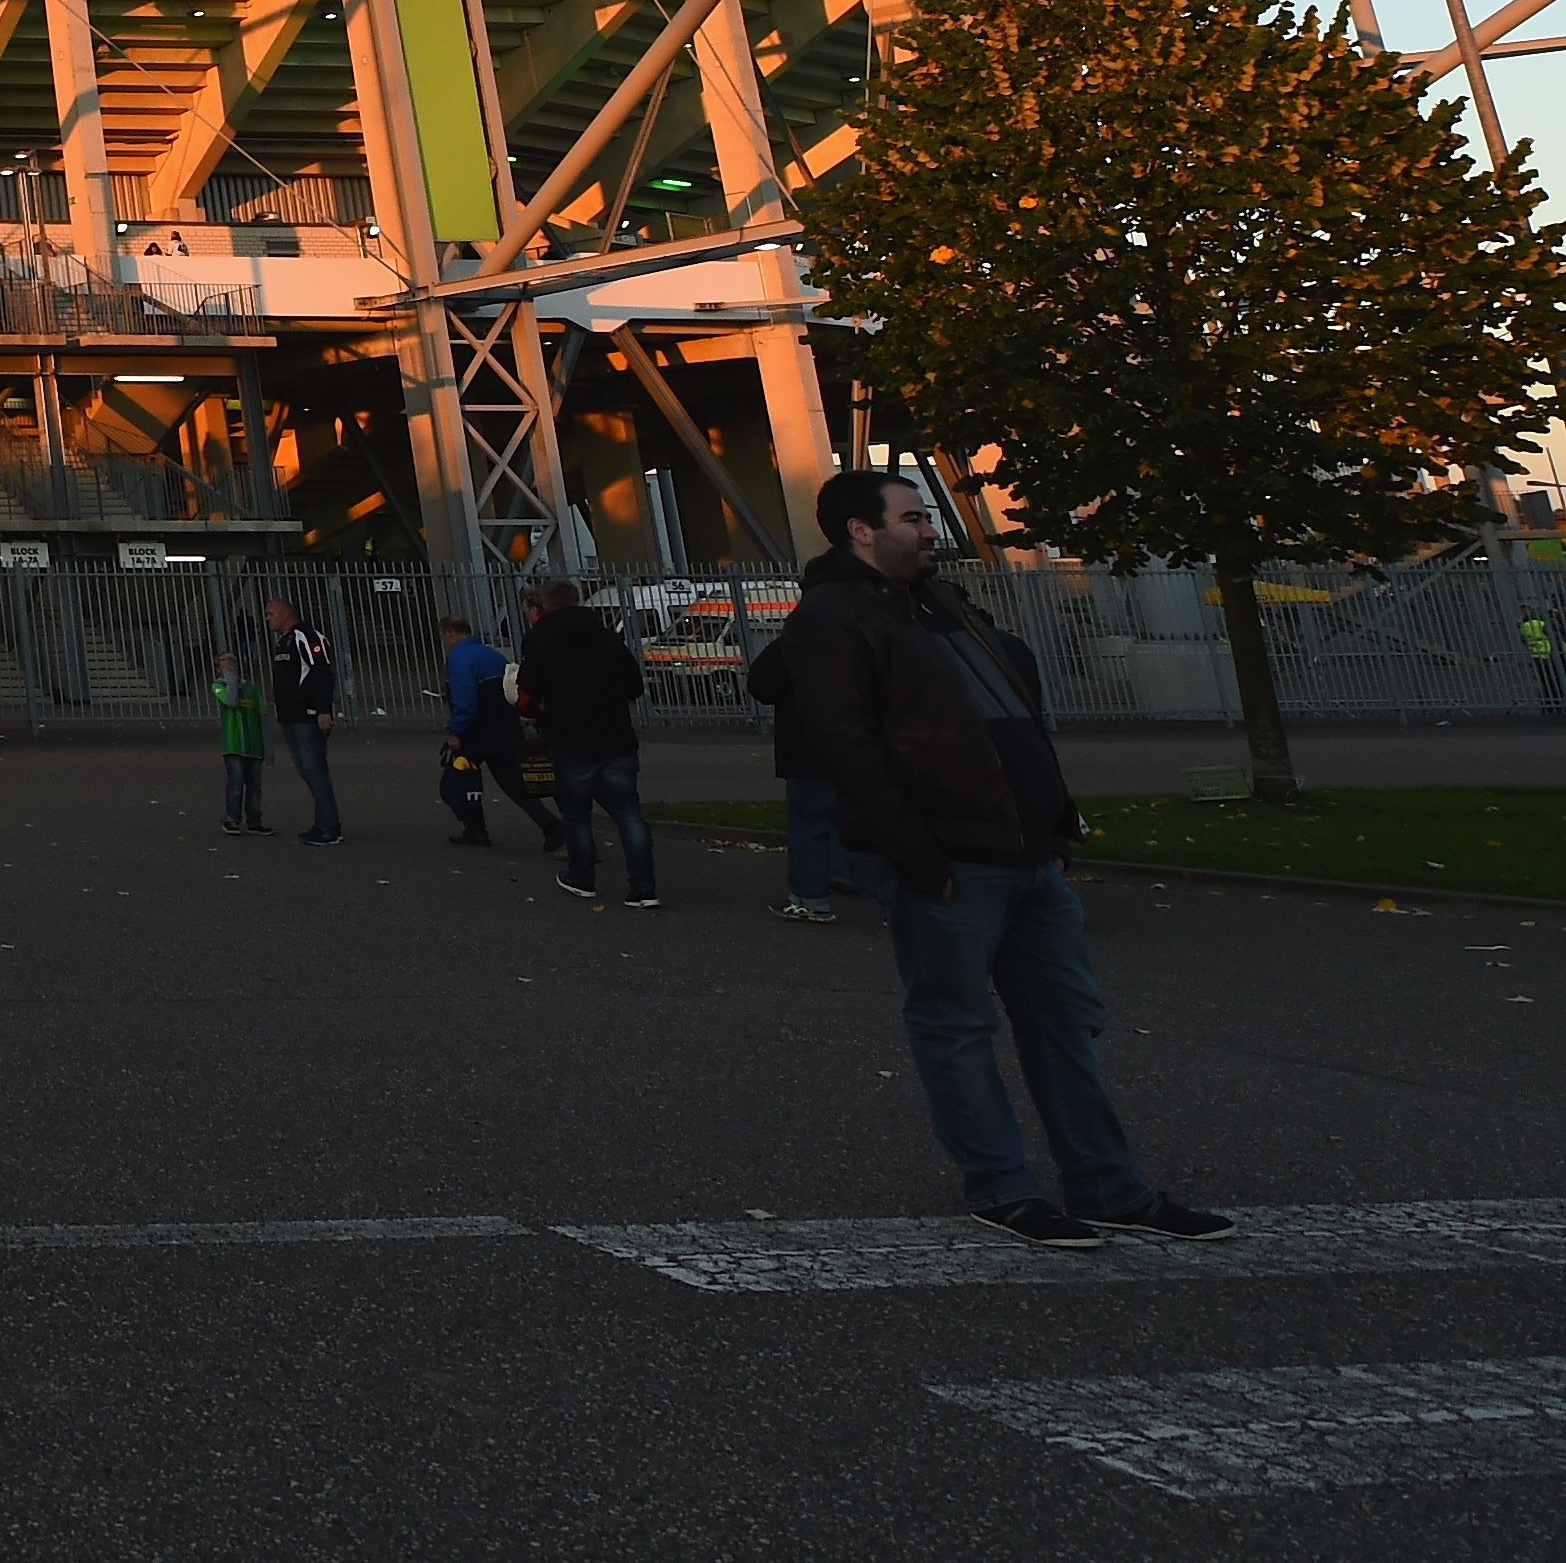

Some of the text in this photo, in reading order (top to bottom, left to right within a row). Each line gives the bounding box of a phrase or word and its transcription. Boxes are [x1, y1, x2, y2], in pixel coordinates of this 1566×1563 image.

[10, 547, 40, 555] BLOCK
[128, 548, 157, 556] BLOCK
[381, 581, 394, 591] 57
[672, 581, 685, 591] 56
